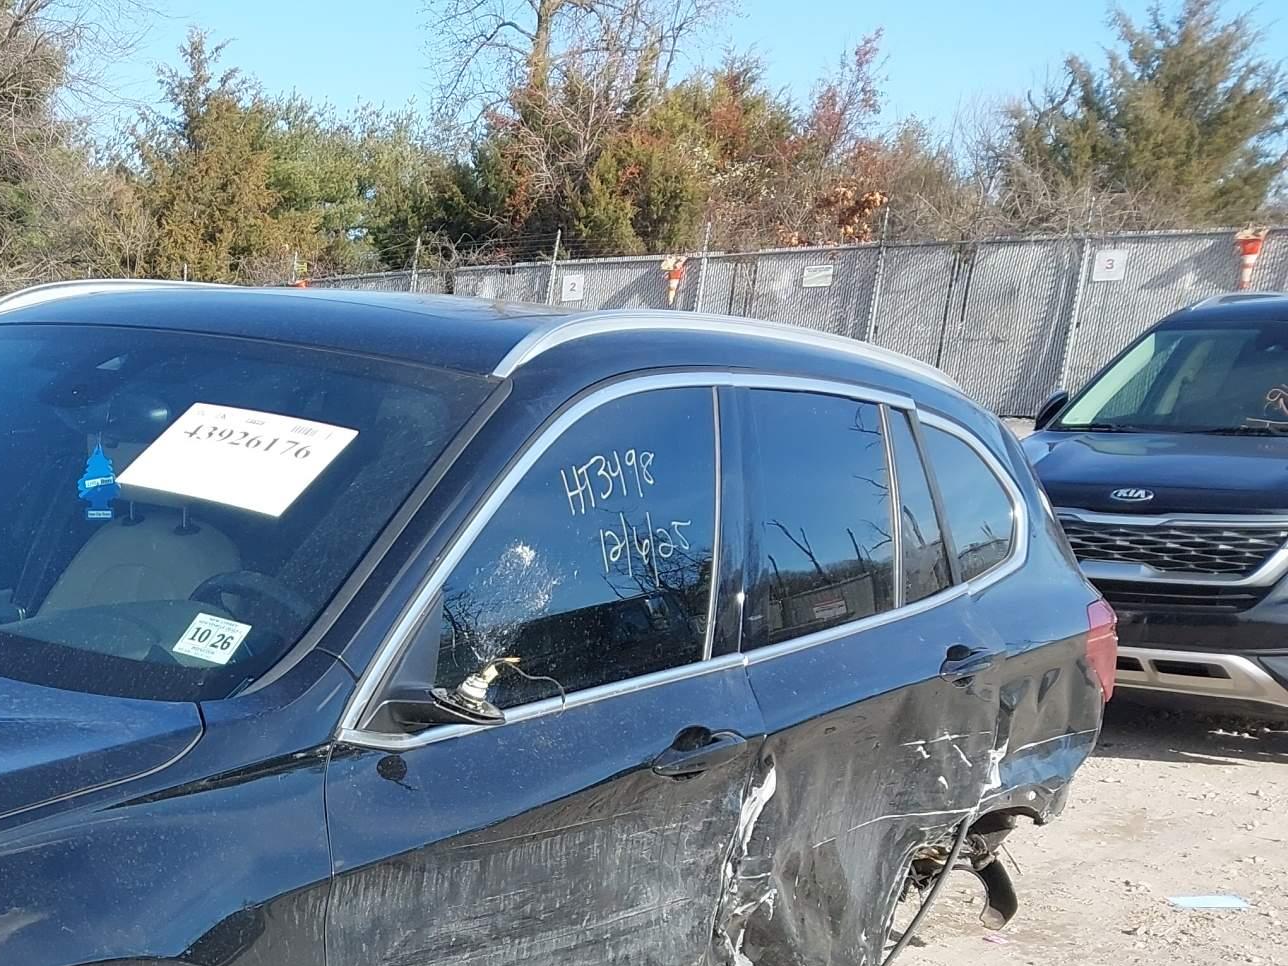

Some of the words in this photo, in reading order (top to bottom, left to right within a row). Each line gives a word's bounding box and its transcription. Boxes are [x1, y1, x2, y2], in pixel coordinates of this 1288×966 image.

[1105, 258, 1114, 270] 3
[569, 282, 577, 292] 2
[184, 424, 312, 459] 43926176
[561, 449, 654, 515] HT3498
[1116, 488, 1146, 499] KIA
[188, 627, 212, 643] 10
[209, 633, 234, 650] 26
